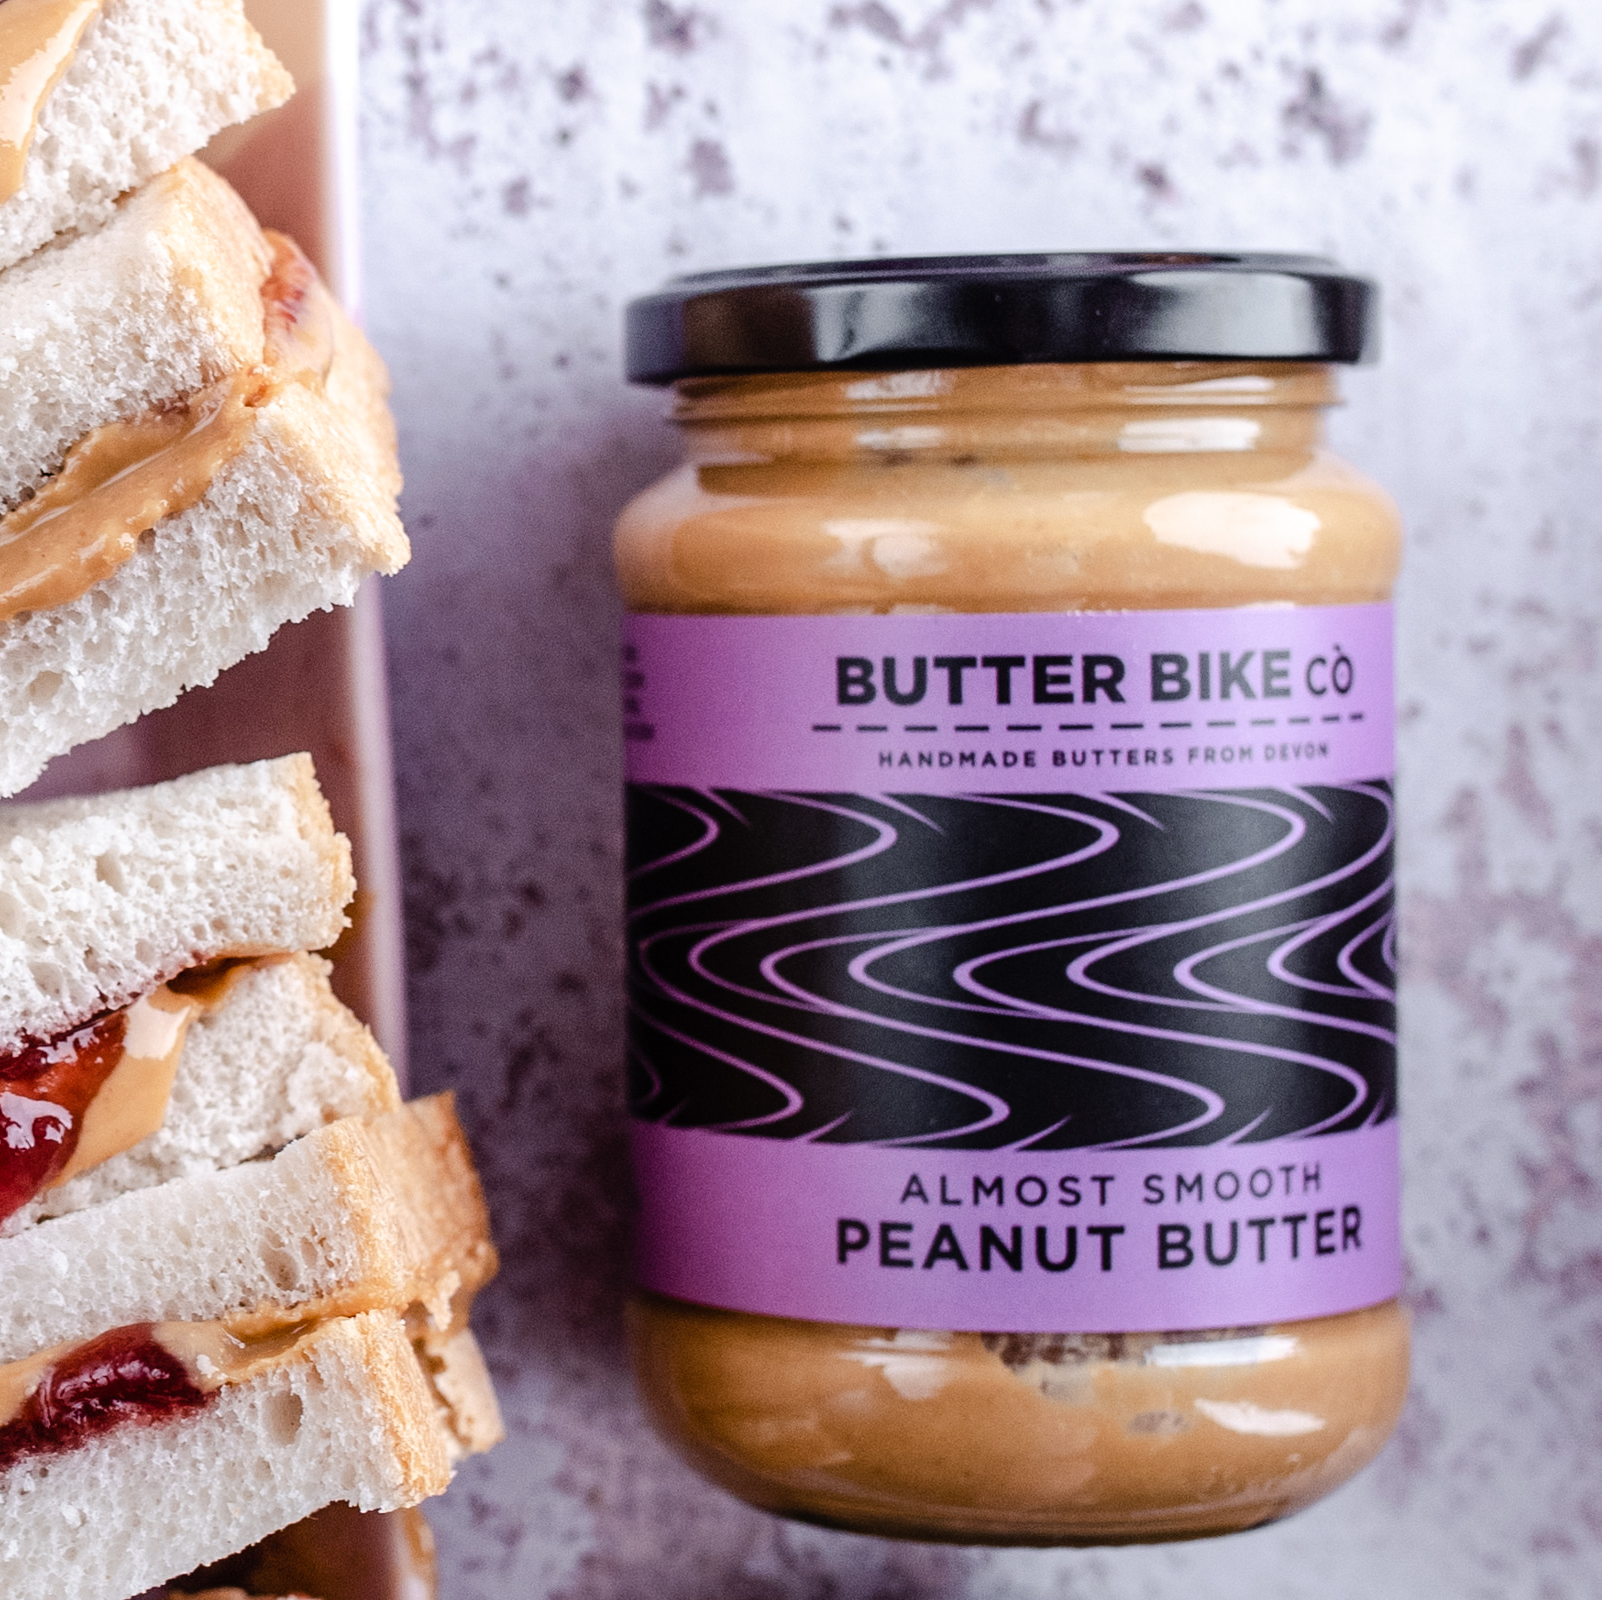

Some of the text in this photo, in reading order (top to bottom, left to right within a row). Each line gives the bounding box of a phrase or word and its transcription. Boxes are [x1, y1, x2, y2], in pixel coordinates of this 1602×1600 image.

[835, 654, 1126, 707] BUTTER
[1149, 649, 1292, 703] BIKE
[878, 742, 1329, 769] HANDMADE BUTTERS FROM DEVON
[900, 1162, 1324, 1208] ALMOST SMOOTH
[835, 1204, 1364, 1274] PEANUT BUTTER
